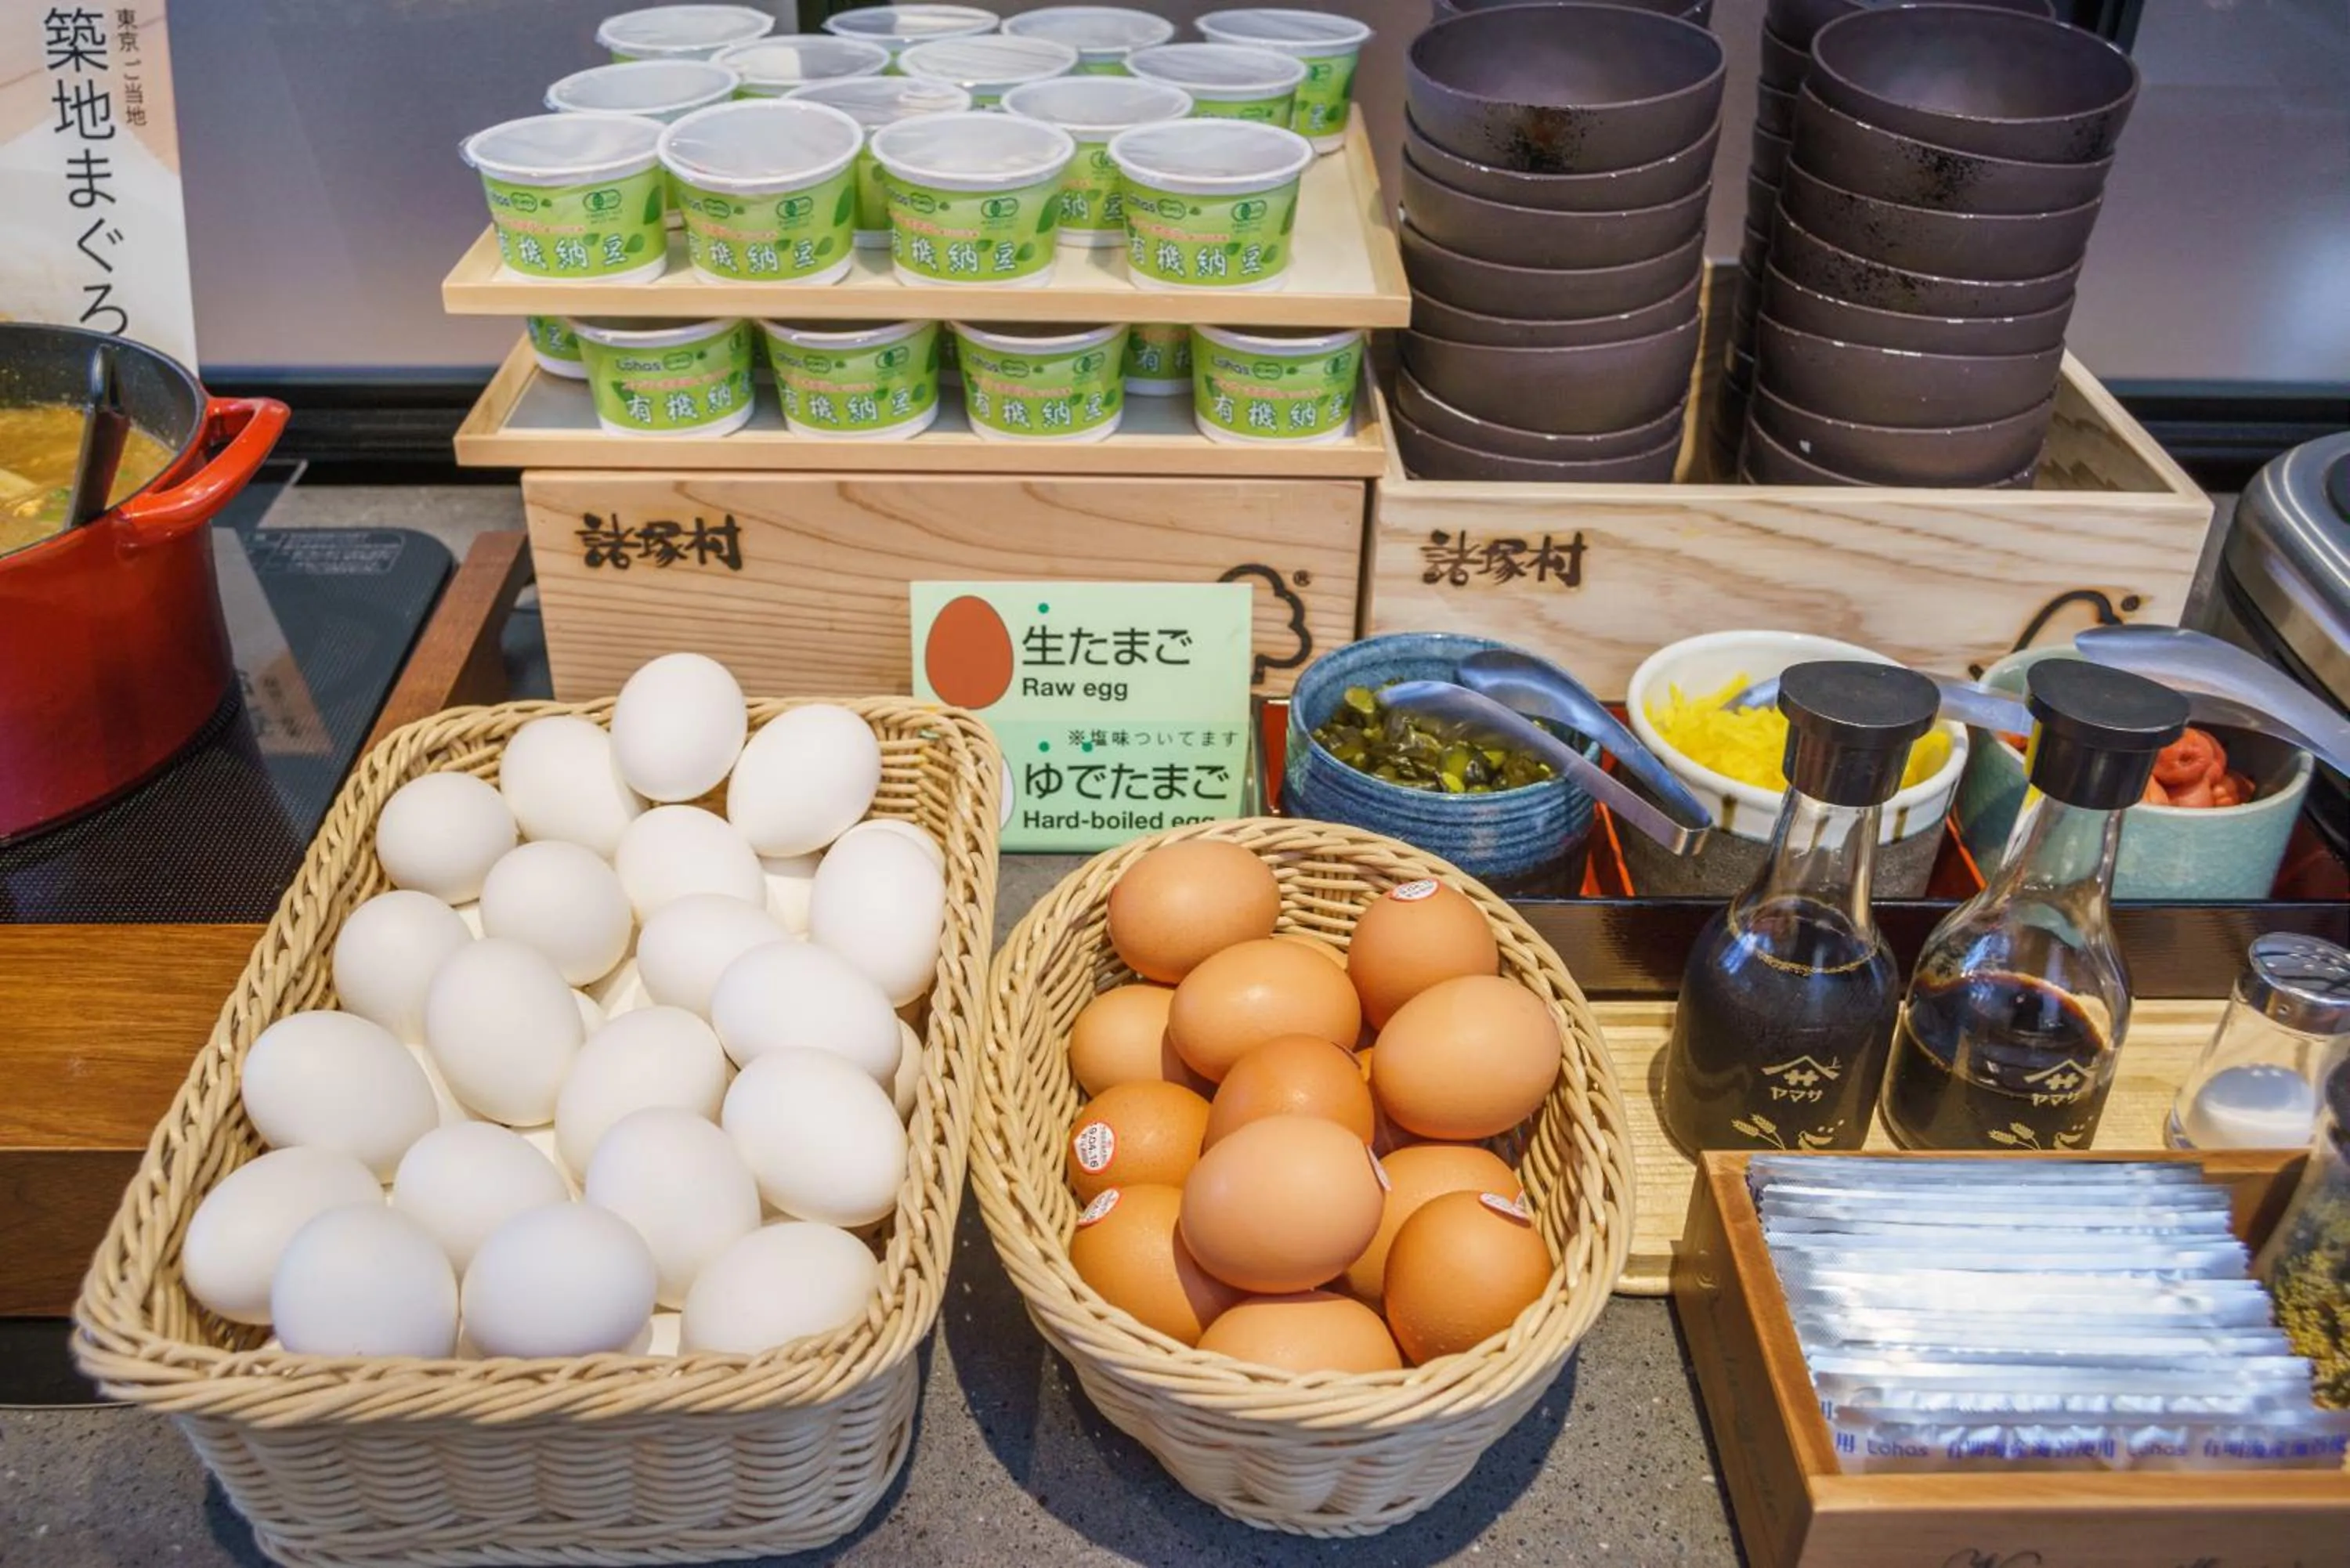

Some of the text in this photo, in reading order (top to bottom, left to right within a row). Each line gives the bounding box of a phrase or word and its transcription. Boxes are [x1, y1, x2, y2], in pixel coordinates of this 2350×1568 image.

[44, 7, 128, 336] 築地まぐろ
[574, 513, 743, 571] 諸塚村
[1419, 529, 1589, 587] 諸塚村
[1021, 624, 1193, 666] 生たまご
[1022, 677, 1129, 702] Raw egg
[1025, 763, 1230, 800] ゆでたまご
[1023, 811, 1164, 829] Hard-boiled
[1770, 1086, 1824, 1103] ヤマサ
[2031, 1092, 2082, 1107] ヤマサ
